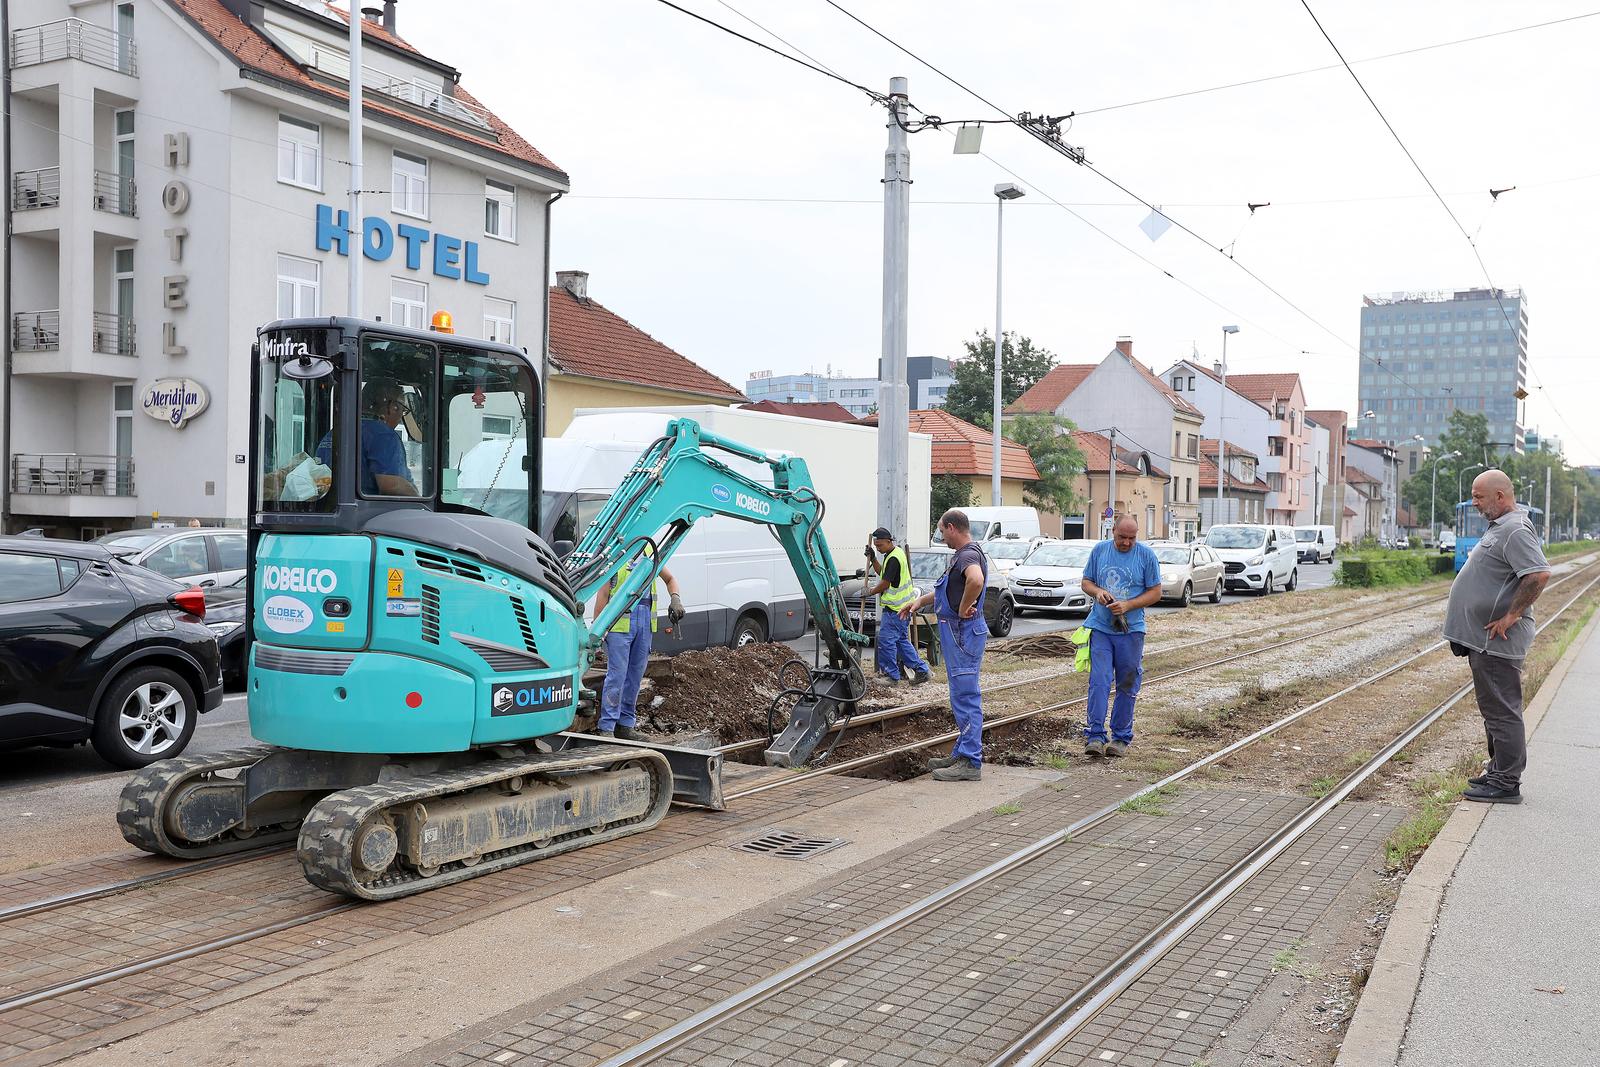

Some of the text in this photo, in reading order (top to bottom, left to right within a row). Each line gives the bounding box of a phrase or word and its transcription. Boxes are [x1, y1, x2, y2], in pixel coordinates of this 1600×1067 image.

[162, 131, 190, 355] HOTEL
[315, 203, 490, 286] HOTEL
[735, 492, 770, 516] KOBELCO
[263, 565, 338, 594] KOBELCO
[267, 606, 305, 619] GLOBEX
[515, 684, 572, 707] OLMinfra
